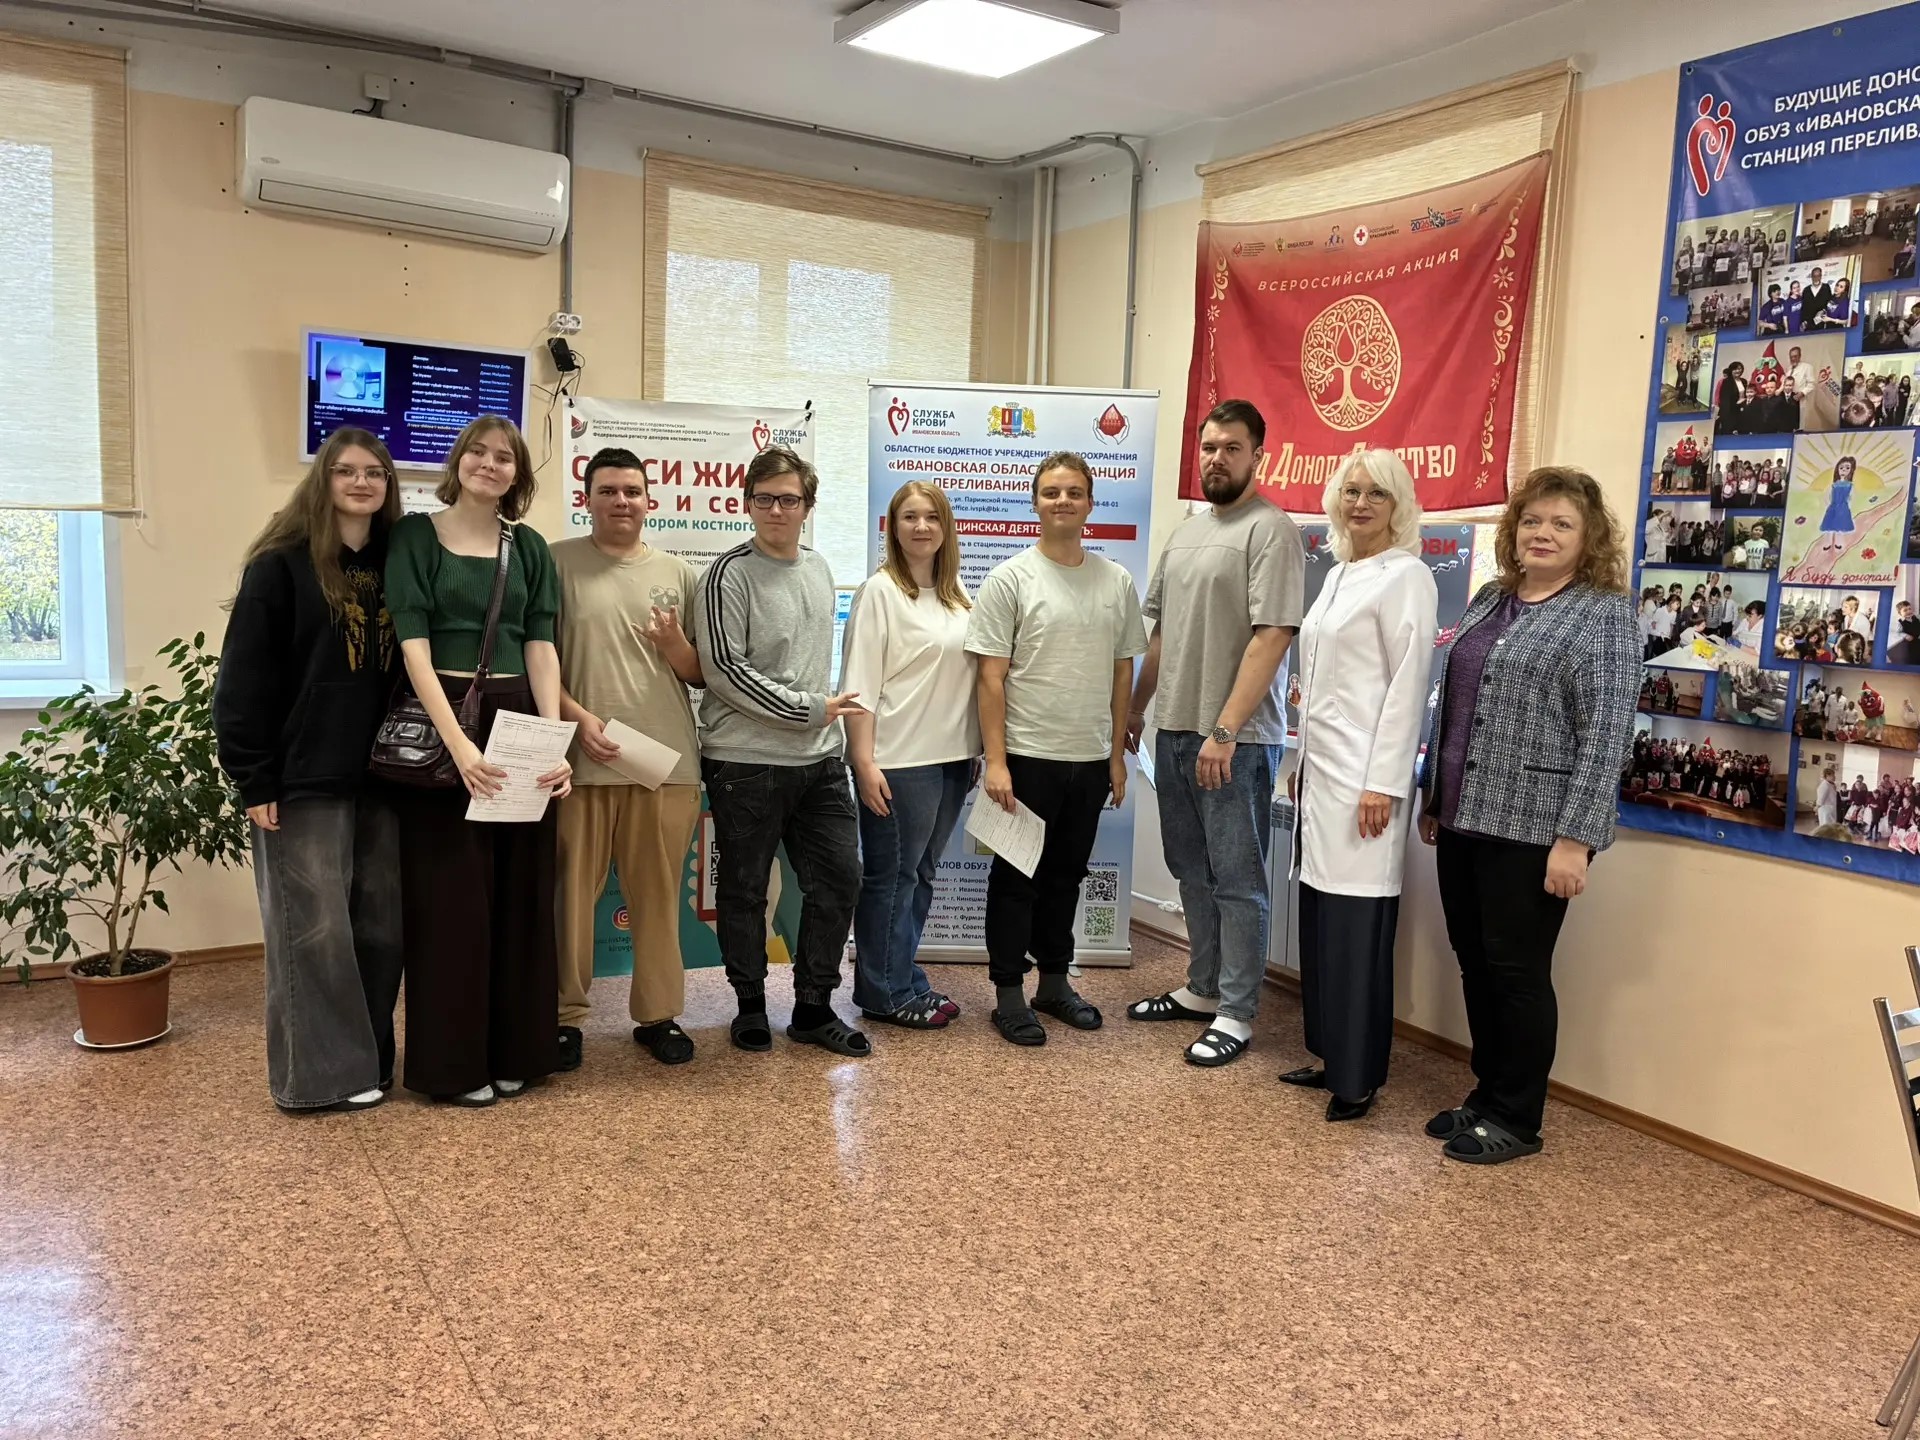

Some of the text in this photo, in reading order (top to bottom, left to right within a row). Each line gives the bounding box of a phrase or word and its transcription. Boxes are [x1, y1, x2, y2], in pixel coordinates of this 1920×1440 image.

[1775, 79, 1862, 113] БУДУЩИЕ
[1744, 122, 1791, 144] ОБУЗ
[1741, 122, 1920, 169] СТАНЦИЯ ПЕРЕЛИВ
[1258, 248, 1459, 292] ВСЕРОССИЙСКАЯ АКЦИЯ
[912, 409, 956, 419] СЛУЖБА
[912, 418, 947, 428] КРОВИ
[772, 429, 807, 437] СЛУЖБА
[772, 436, 801, 444] КРОВИ
[884, 444, 935, 454] ОБЛАСТНОЕ
[937, 446, 993, 457] БЮДЖЕТНОЕ
[994, 449, 1051, 459] УЧРЕЖДЕНИЕ
[888, 459, 1137, 480] «ИВАНОВСКАЯ ОБЛАС АНЦИЯ
[933, 477, 1030, 492] ПЕРЕЛИВАНИЯ
[676, 494, 691, 512] и
[964, 496, 1000, 504] Парижской
[951, 505, 1009, 513] office.ivspk@bk.ru
[643, 517, 688, 531] нором
[955, 521, 1006, 533] ЦИНСКАЯ
[973, 542, 1025, 550] стационарных
[1780, 566, 1797, 583] Я
[1801, 565, 1836, 585] буду
[935, 861, 988, 870] АЛОВ ОБУЗ
